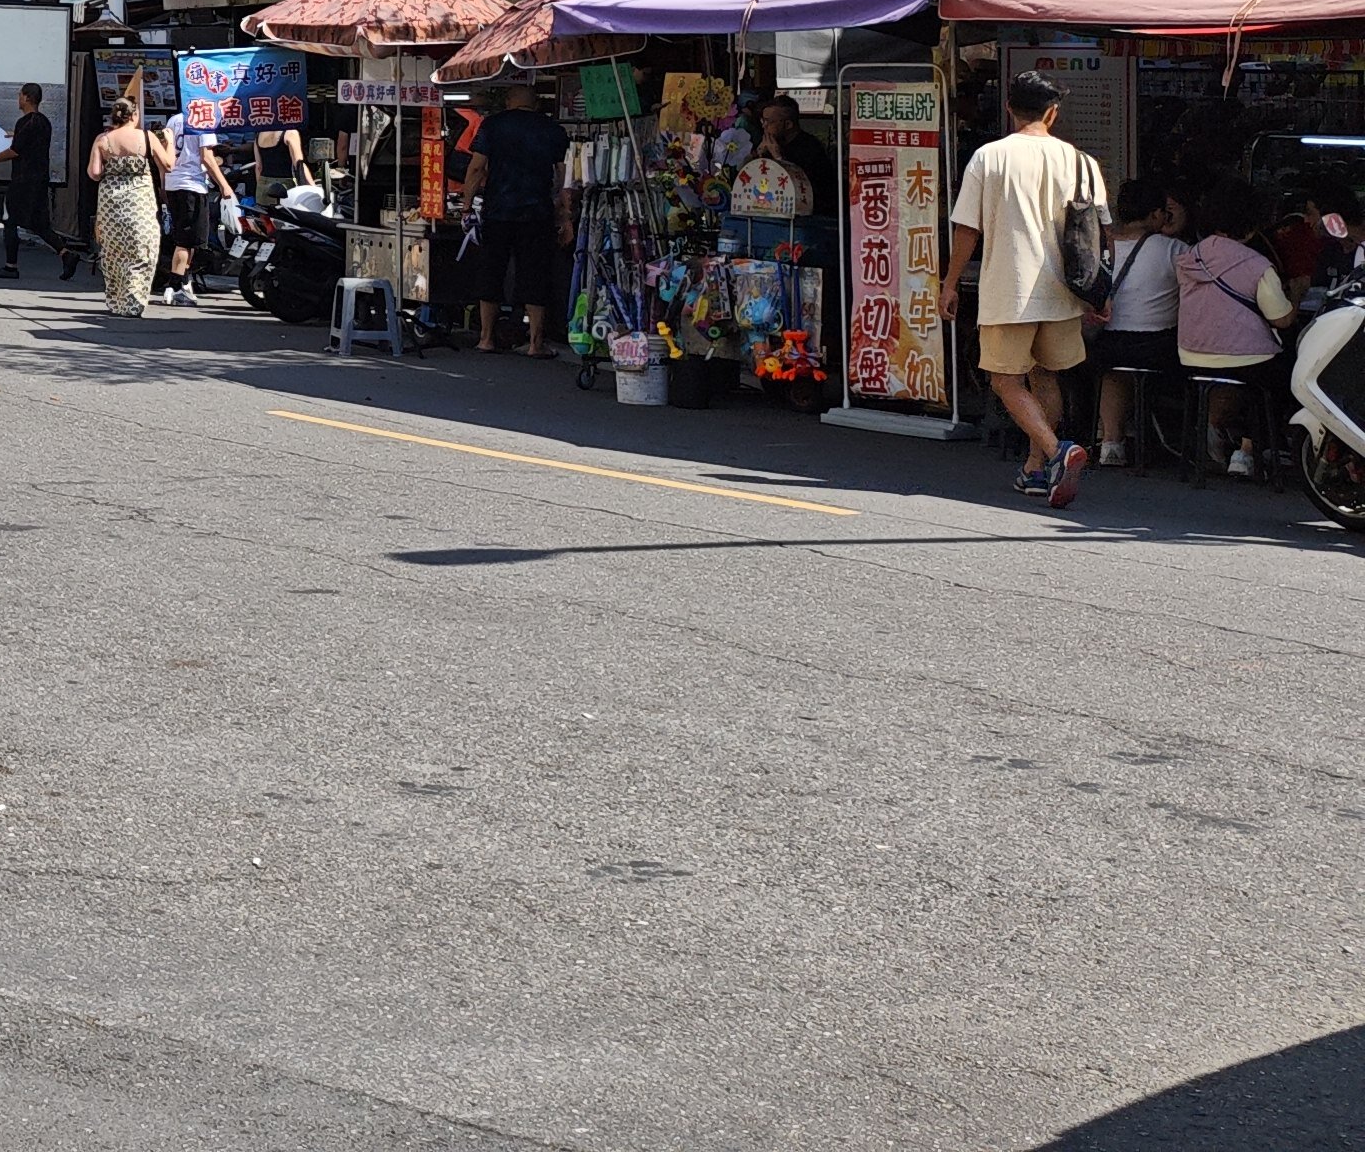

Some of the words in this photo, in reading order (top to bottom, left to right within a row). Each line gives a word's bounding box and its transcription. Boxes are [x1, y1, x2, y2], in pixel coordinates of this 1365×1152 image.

[230, 61, 302, 86] 真好呷
[188, 95, 303, 129] 旗魚黑輪
[857, 92, 936, 121] 津鮮果汁
[873, 131, 920, 145] 三代老店
[859, 179, 891, 396] 番茄切盤
[906, 161, 938, 401] 木瓜牛奶
